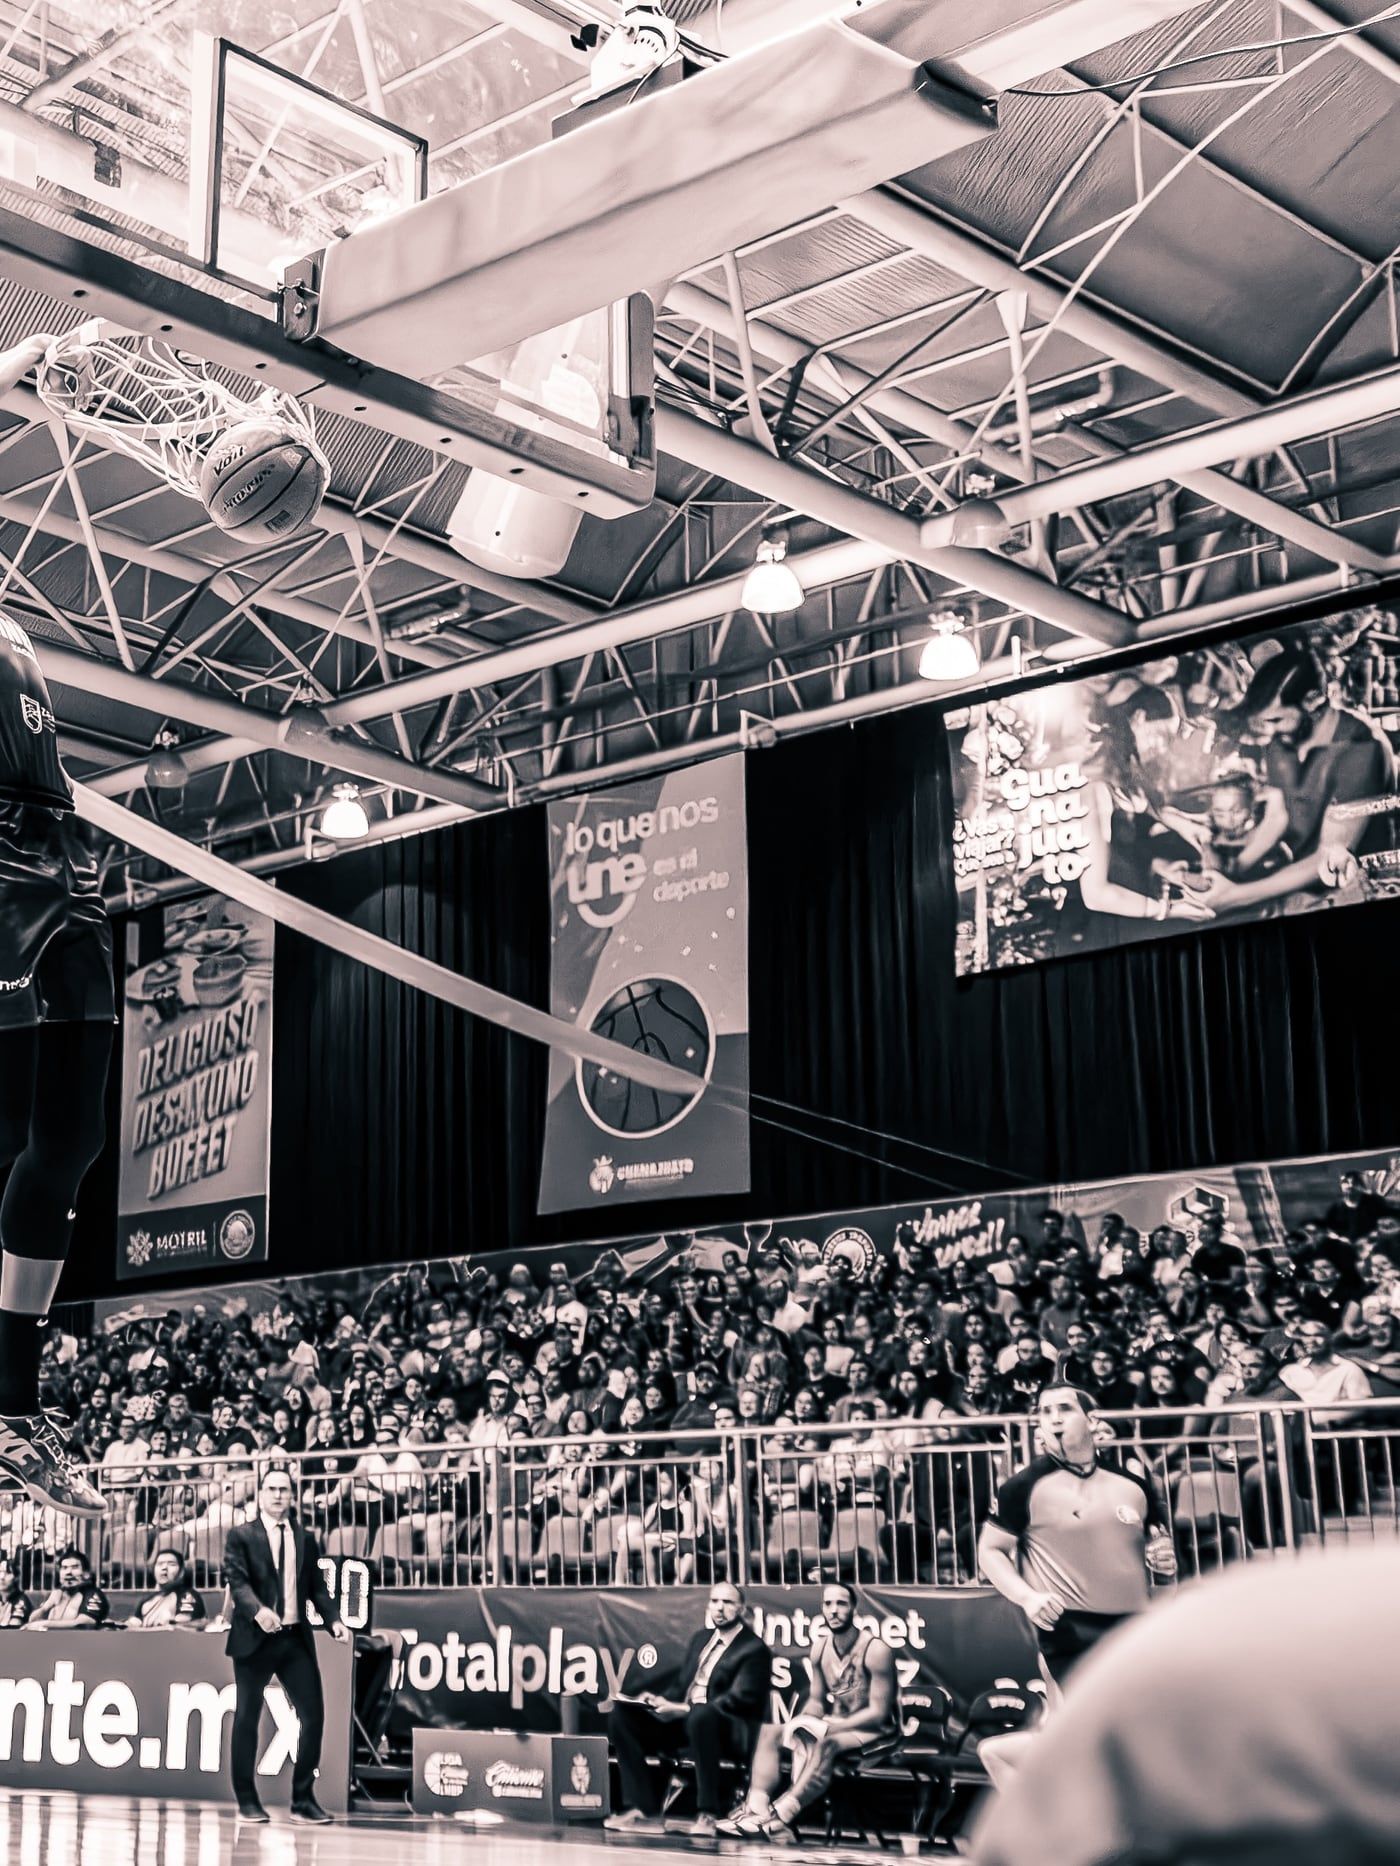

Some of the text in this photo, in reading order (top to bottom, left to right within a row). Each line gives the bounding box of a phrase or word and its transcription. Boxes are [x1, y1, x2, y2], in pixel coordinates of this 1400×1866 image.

[566, 797, 719, 855] lo que nos
[566, 853, 648, 904] une
[138, 998, 260, 1097] DELICIOSO
[135, 1051, 259, 1151] DESAYUNO
[149, 1116, 237, 1198] BUFFET
[753, 1606, 926, 1649] Intenet
